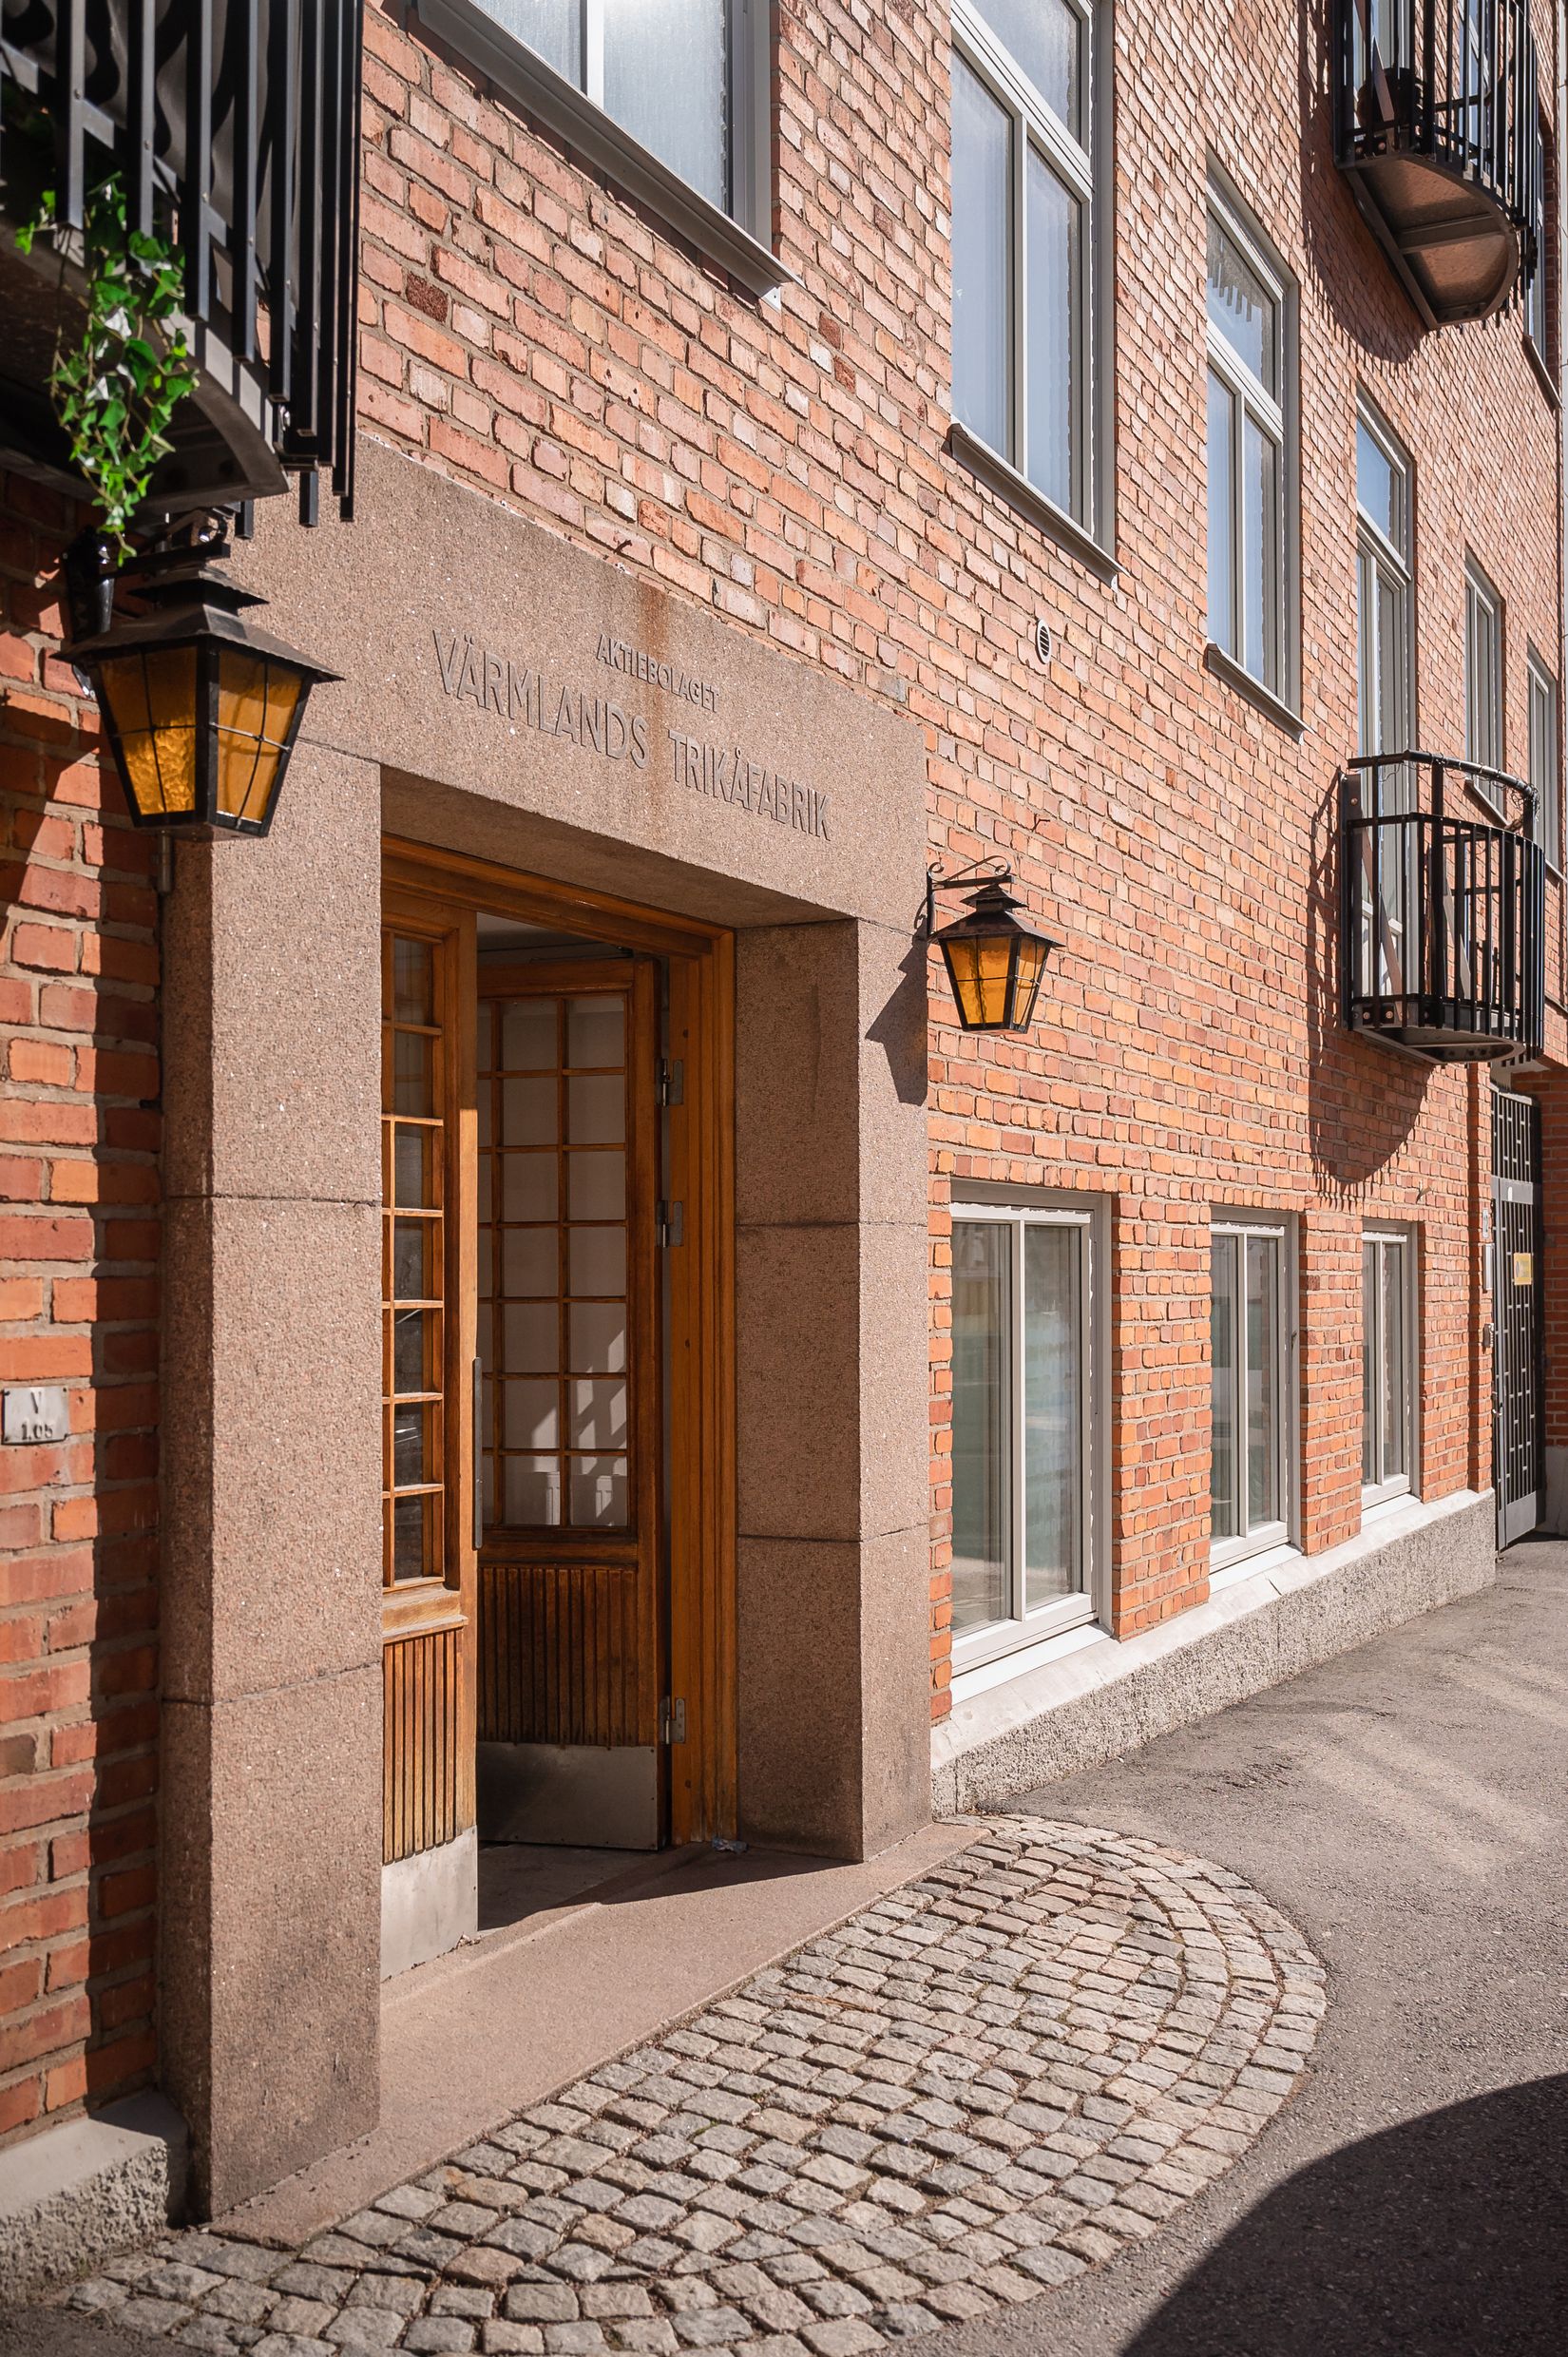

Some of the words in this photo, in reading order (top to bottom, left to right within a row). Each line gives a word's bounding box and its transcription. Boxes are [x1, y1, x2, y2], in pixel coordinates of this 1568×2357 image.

[432, 629, 650, 770] VÄRMLANDS
[667, 729, 832, 841] TRIKÅFABRIK
[596, 634, 719, 713] AKTIEBOLAGET
